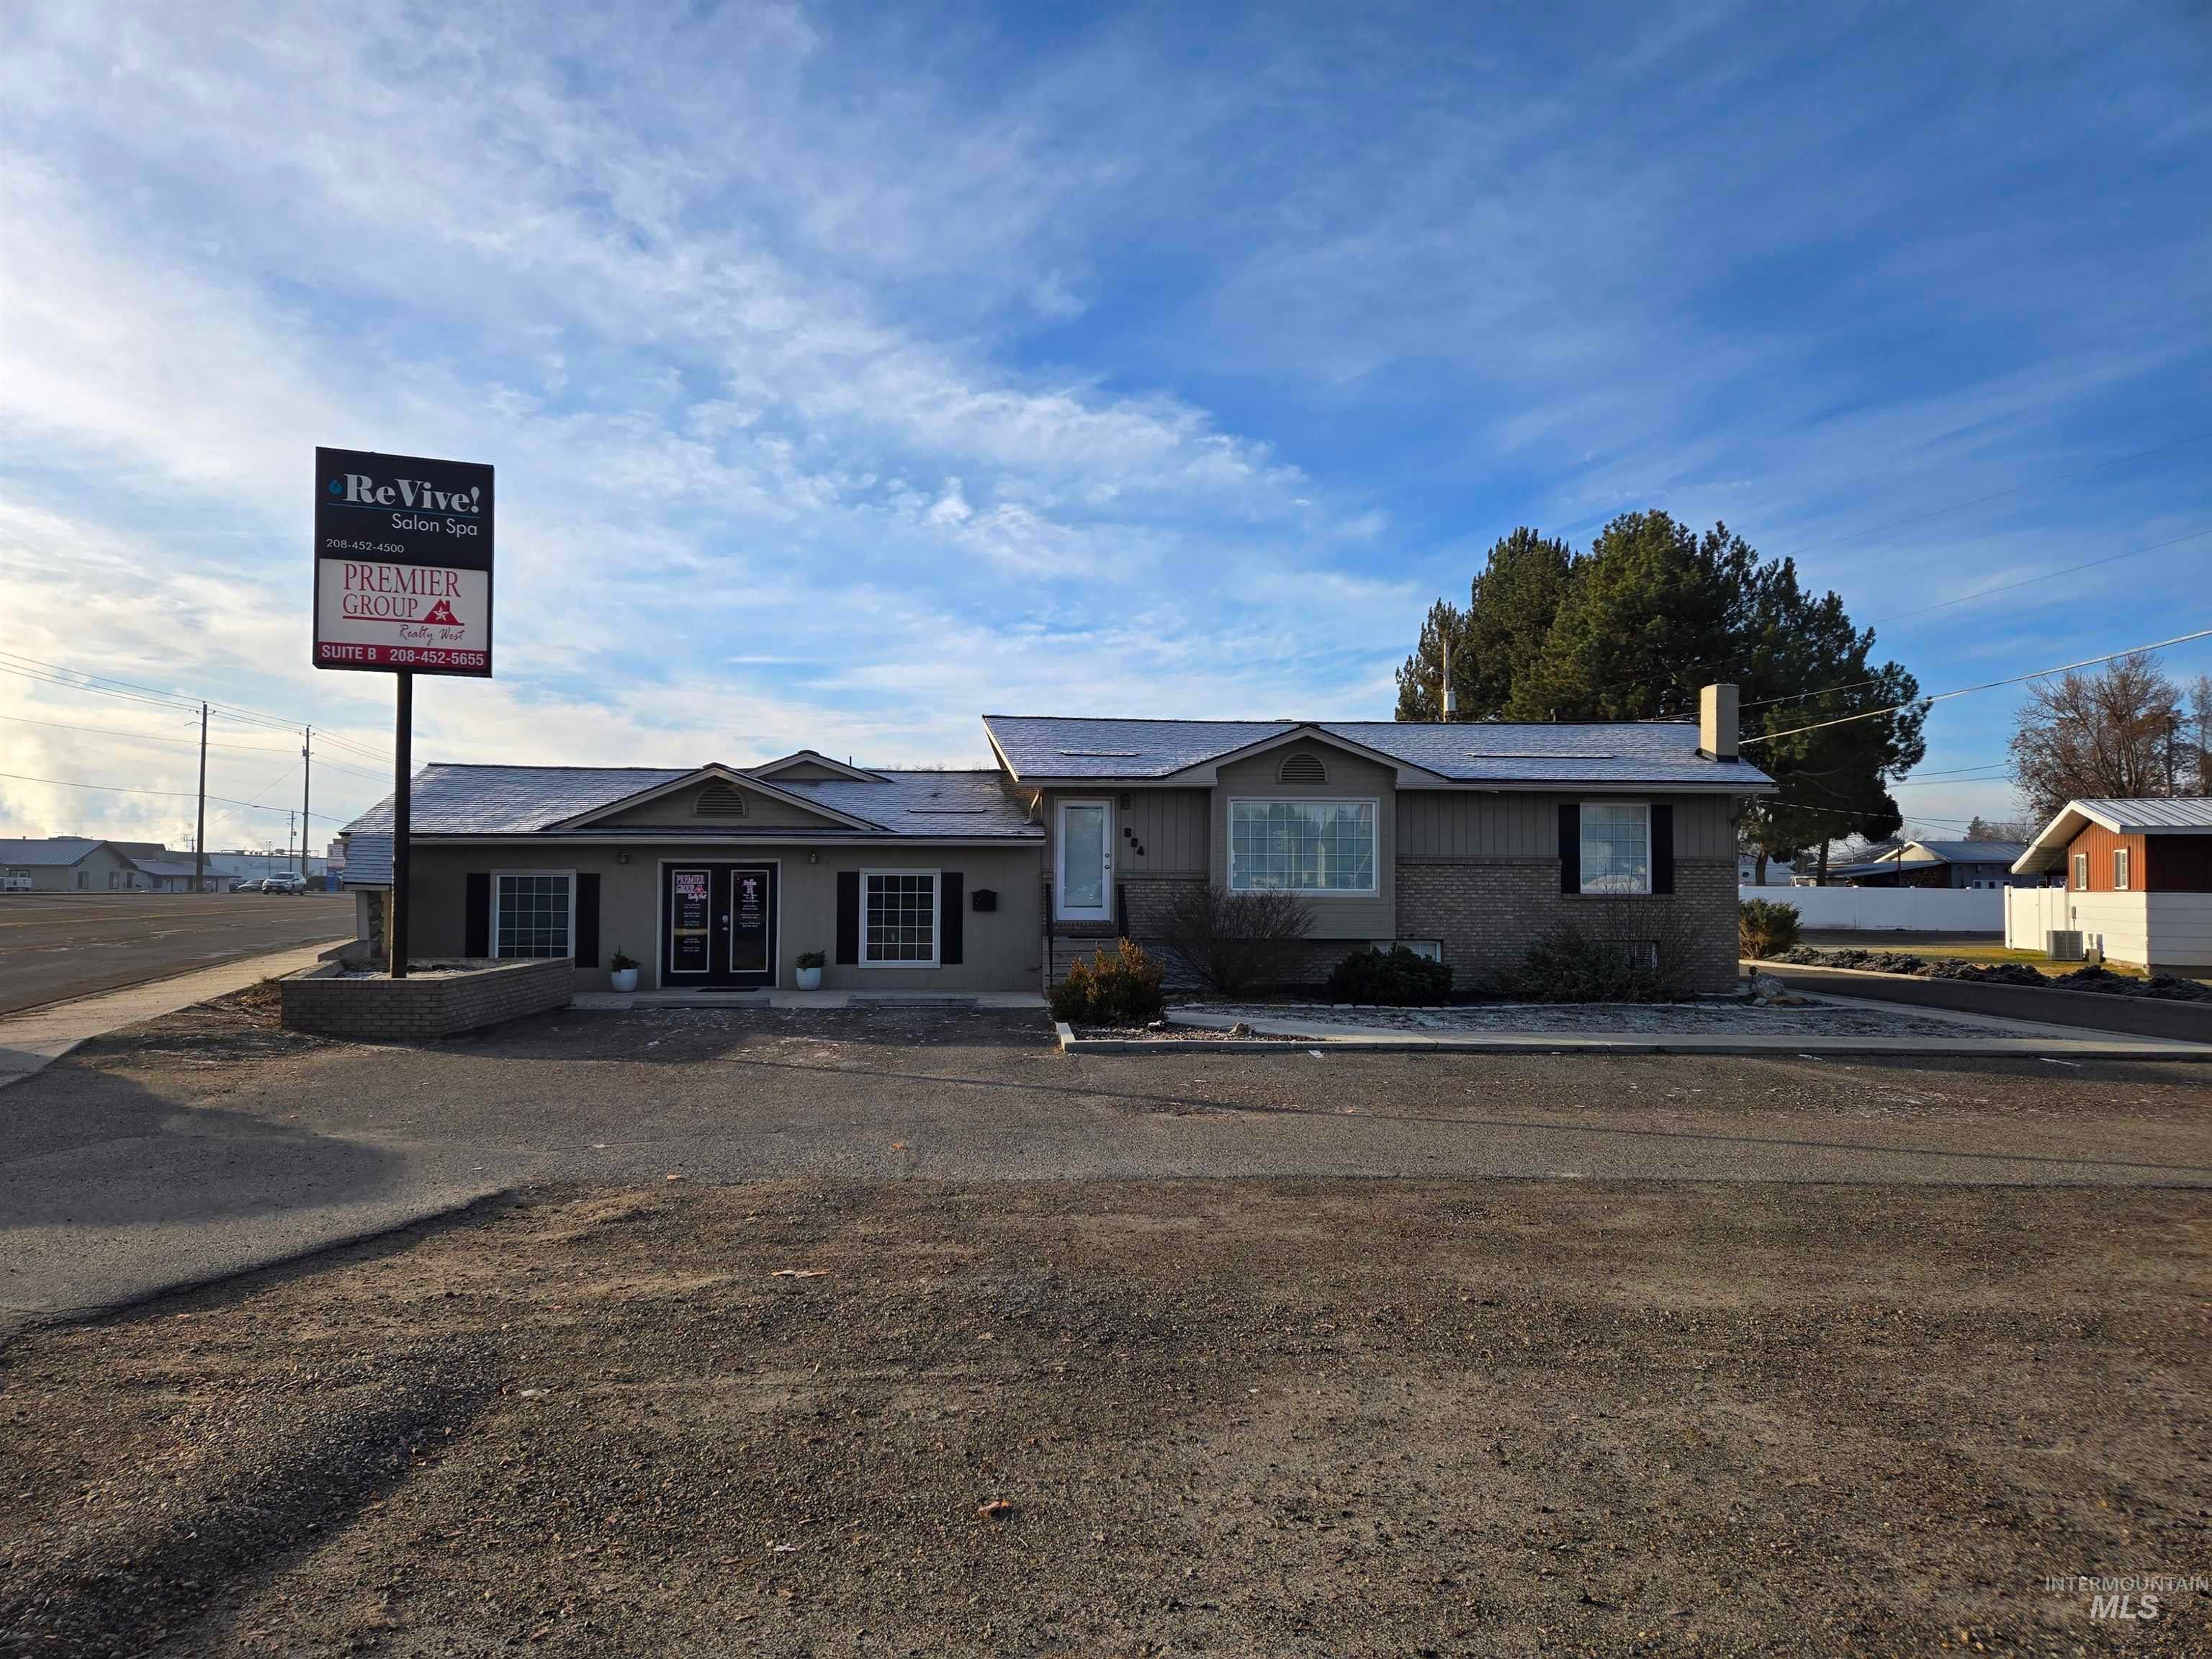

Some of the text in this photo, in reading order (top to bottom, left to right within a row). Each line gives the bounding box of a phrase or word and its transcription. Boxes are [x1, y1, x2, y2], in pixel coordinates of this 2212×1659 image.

[342, 473, 480, 513] ReVive!
[392, 513, 477, 538] Salon Spa
[325, 539, 404, 553] 208-452-4500
[343, 563, 462, 598] PREMIER
[343, 593, 418, 618] GROUP
[398, 624, 465, 647] Realty West
[321, 644, 485, 666] SUITE B 208-452-5655
[675, 874, 705, 884] PREMIER
